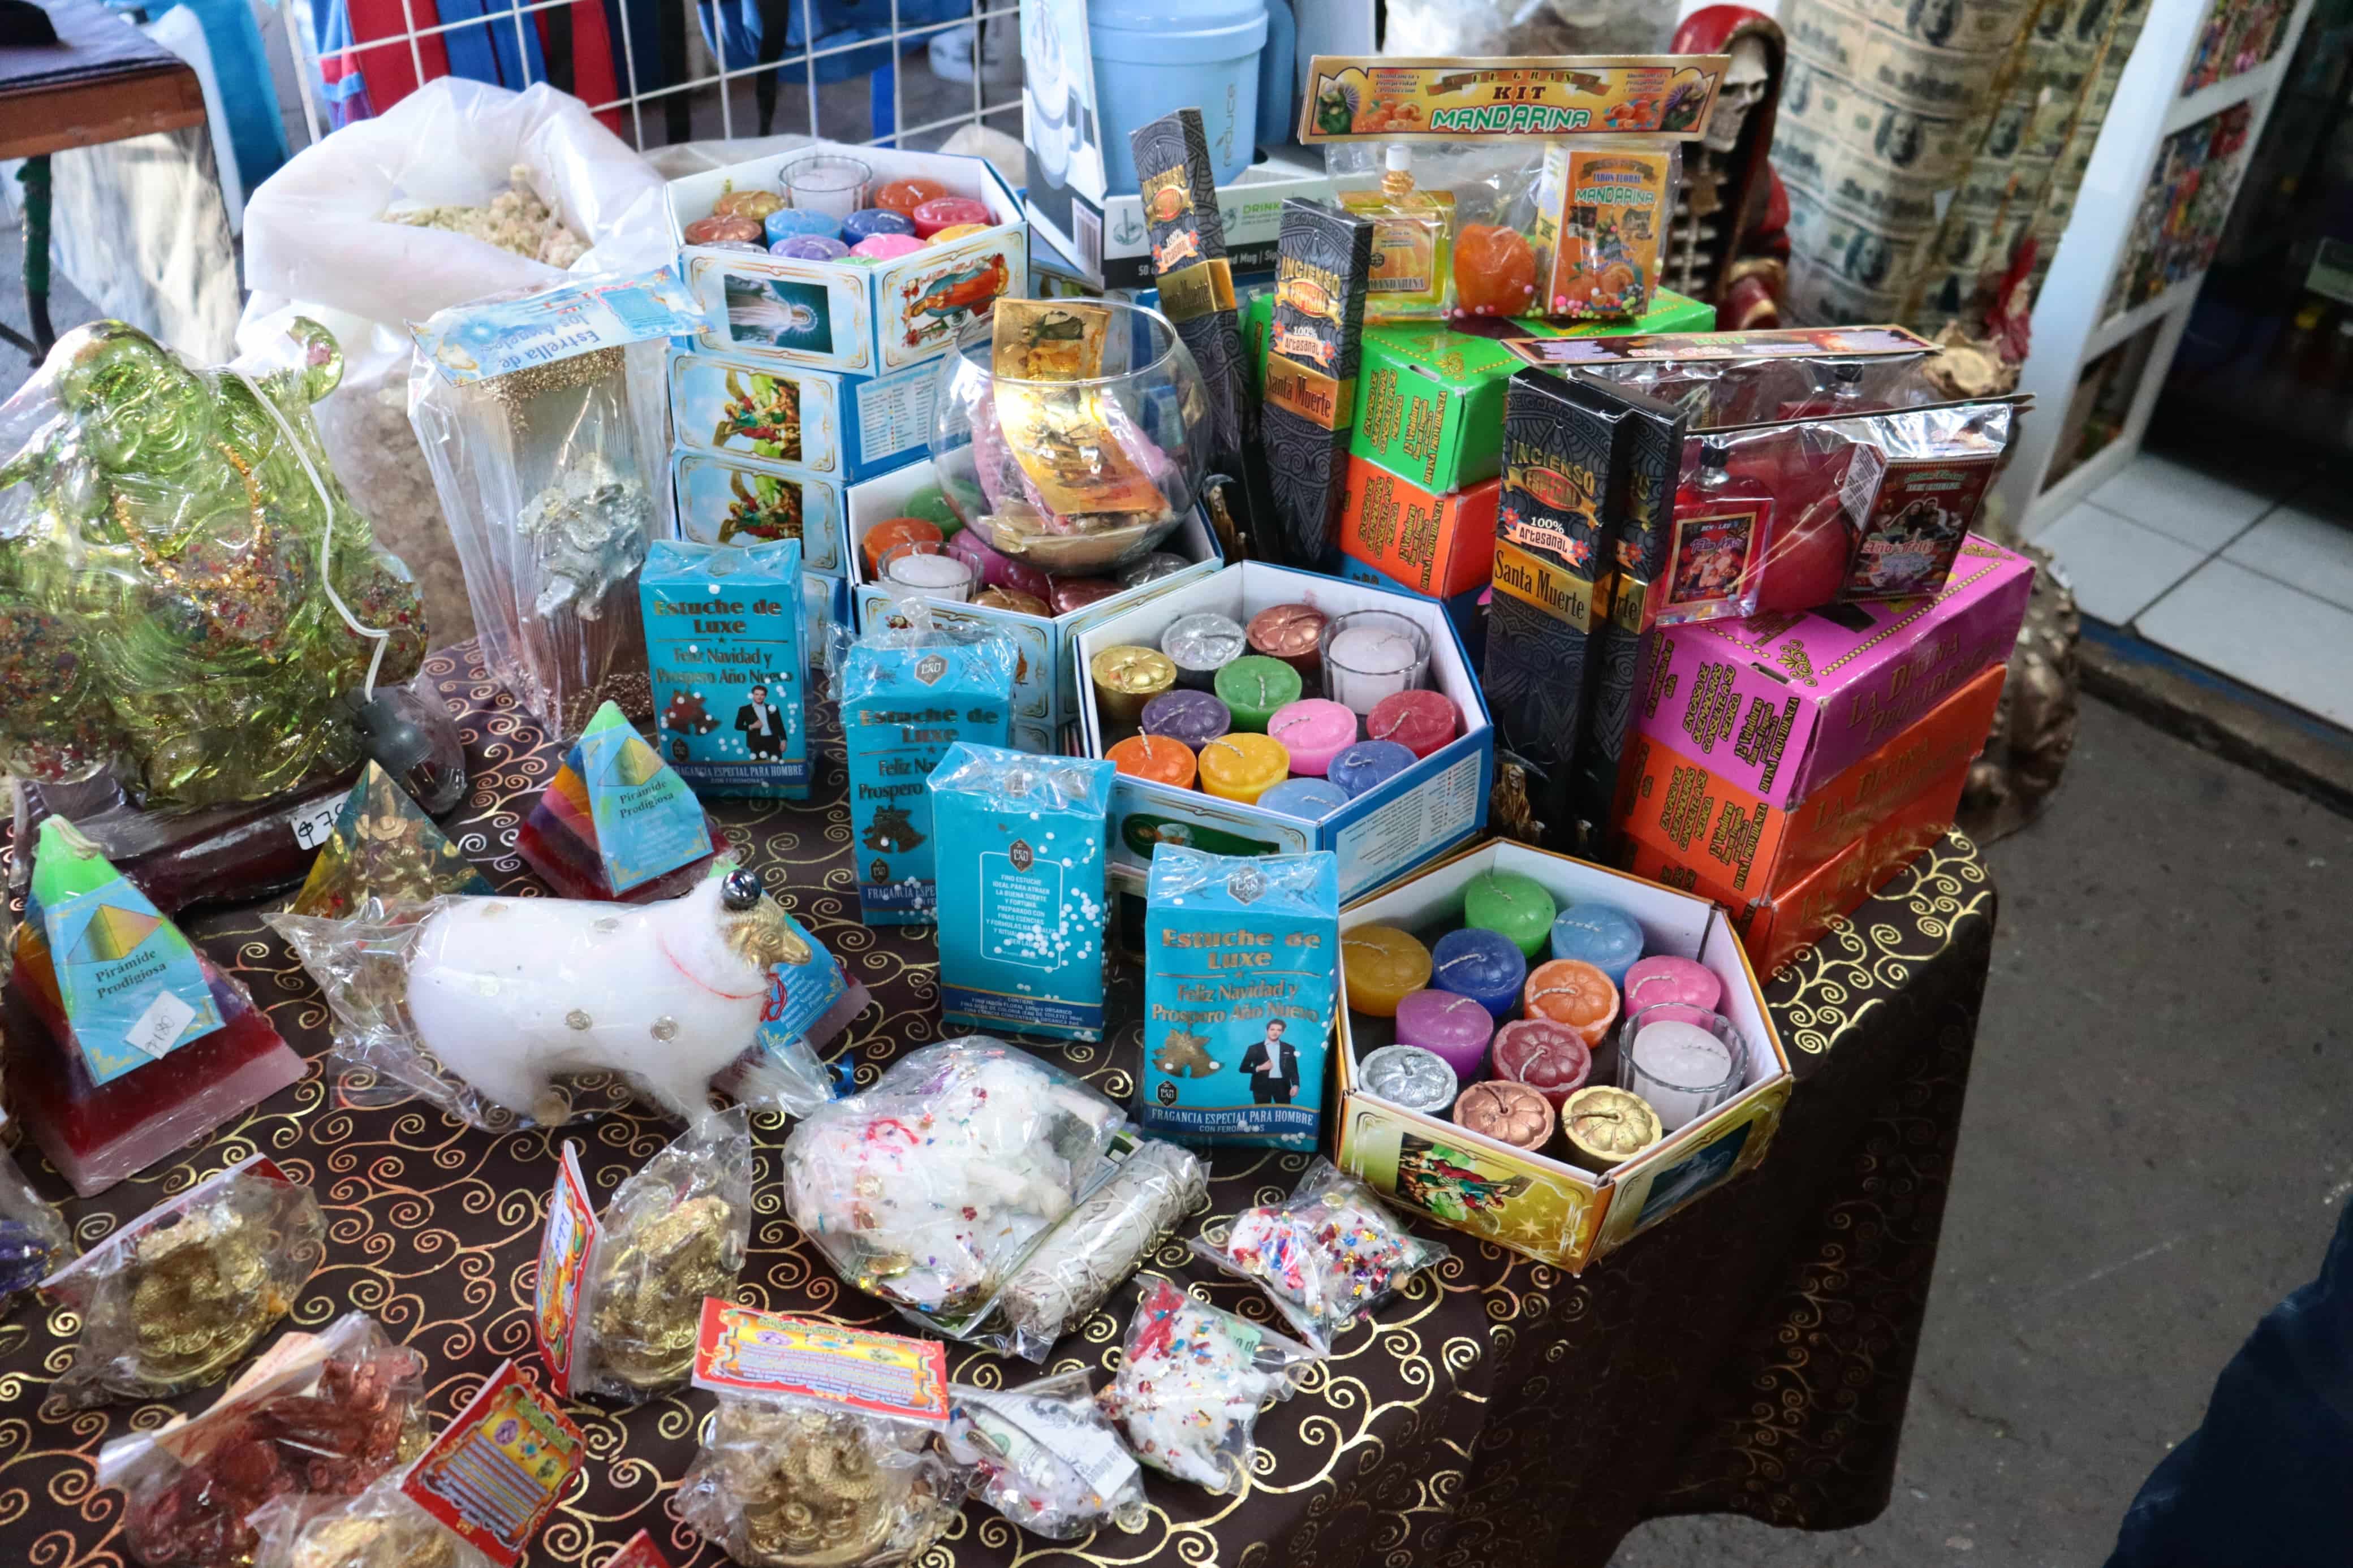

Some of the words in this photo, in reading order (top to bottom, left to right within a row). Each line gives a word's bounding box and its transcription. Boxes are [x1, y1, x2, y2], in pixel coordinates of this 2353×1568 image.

[1493, 86, 1546, 100] KIT
[1222, 83, 1236, 167] reduce
[1431, 104, 1591, 133] MANDARINA
[1575, 187, 1655, 205] MANDARINA
[1242, 202, 1281, 215] DRINK
[1240, 253, 1257, 265] Mug
[1139, 265, 1152, 276] 50
[1281, 256, 1340, 300] INCIENSO
[1294, 326, 1317, 340] 100%
[528, 330, 600, 361] Estrella
[502, 355, 522, 369] de
[1266, 362, 1292, 400] Santa
[1295, 375, 1331, 418] Muerte
[1430, 391, 1447, 452] PROVIDENCIA
[1424, 453, 1438, 485] DIVINA
[1511, 440, 1594, 496] INCIENSO
[1527, 473, 1578, 506] ESPECIAL
[1531, 516, 1565, 534] 100%
[1519, 527, 1567, 552] Artesanal
[1495, 548, 1532, 594] Santa
[1537, 568, 1584, 620] Muerte
[654, 599, 744, 616] Estuche
[753, 600, 782, 616] de
[694, 619, 747, 634] Luxe
[707, 649, 760, 664] Navidad
[764, 652, 773, 669] y
[657, 669, 716, 688] Prospero
[719, 669, 746, 684] Año
[750, 669, 793, 684] Nuevo
[1699, 664, 1710, 682] DE
[1688, 683, 1704, 715] CASO
[1692, 663, 1723, 744] QUEMADURAS
[1703, 694, 1727, 753] CONSULTE
[1725, 665, 1735, 683] SU
[859, 709, 958, 726] Estuche
[967, 708, 999, 724] de
[1848, 690, 1878, 729] LA
[1683, 715, 1695, 732] EN
[1740, 697, 1764, 745] Veladoras
[902, 728, 960, 743] Luxe
[1759, 761, 1778, 794] DIVINA
[1770, 697, 1800, 760] PROVIDENCIA
[675, 767, 713, 777] RAGANCIA
[714, 766, 749, 777] ESPECIAL
[751, 766, 769, 777] PARA
[771, 765, 803, 776] HOMBRE
[879, 760, 911, 777] Feliz
[620, 780, 667, 804] Pirámide
[859, 784, 923, 803] Prospero
[619, 792, 674, 819] Prodigiosa
[1713, 801, 1735, 845] Veladoras
[1734, 860, 1751, 891] DIVINA
[1743, 803, 1769, 861] PROVIDENCIA
[1016, 876, 1041, 885] ESTUCHE
[1027, 886, 1050, 895] ATRAER
[1025, 893, 1047, 902] SUERTE
[997, 905, 1032, 915] PREPARADO
[1016, 915, 1044, 925] ESENCIAS
[991, 919, 1022, 929] FORMULAS
[1162, 928, 1274, 948] Estuche
[1285, 931, 1322, 949] de
[95, 949, 157, 983] Pirámide
[1208, 951, 1273, 969] Luxe
[97, 963, 167, 999] Prodigiosa
[1178, 984, 1215, 1003] Feliz
[1218, 980, 1285, 1001] Navidad
[1287, 983, 1299, 1001] y
[1152, 1004, 1226, 1027] Prospero
[1231, 1003, 1262, 1019] Año
[1266, 1001, 1318, 1023] Nuevo
[1152, 1108, 1202, 1124] FRAGANCIA
[1205, 1112, 1247, 1125] ESPECIAL
[1249, 1109, 1273, 1123] PARA
[1275, 1110, 1313, 1126] HOMBRE
